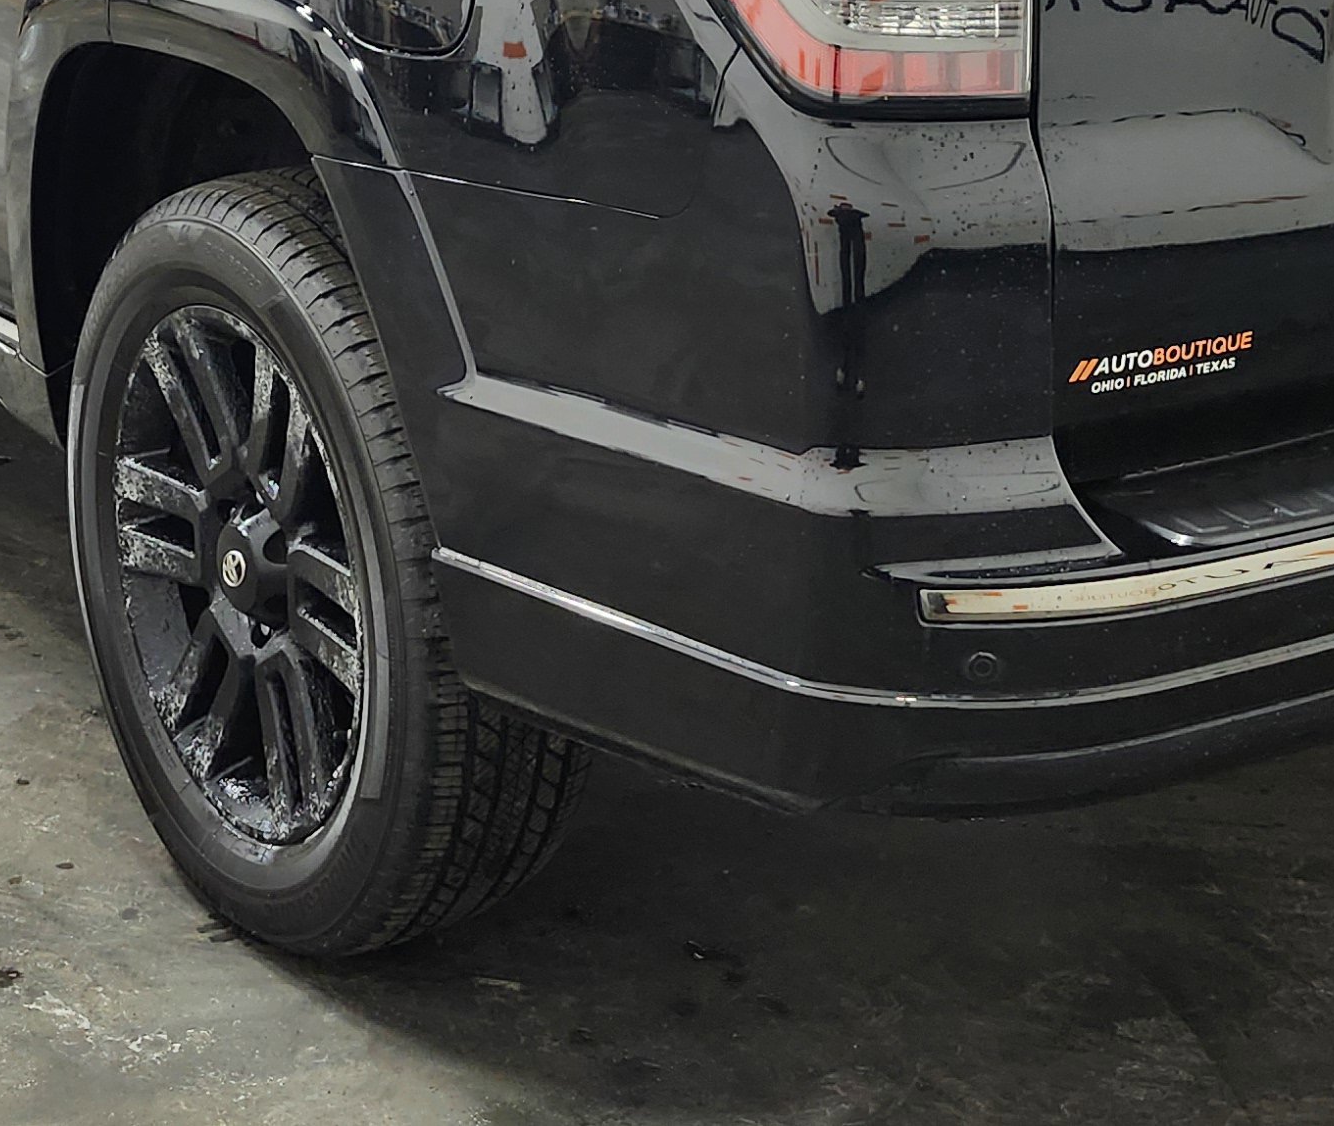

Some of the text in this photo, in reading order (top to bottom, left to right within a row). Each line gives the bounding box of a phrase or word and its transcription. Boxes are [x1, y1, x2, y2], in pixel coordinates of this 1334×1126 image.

[1093, 331, 1254, 376] AUTOBOUTIQUE
[1091, 357, 1236, 394] OHIO FLORIDA TEXAS
